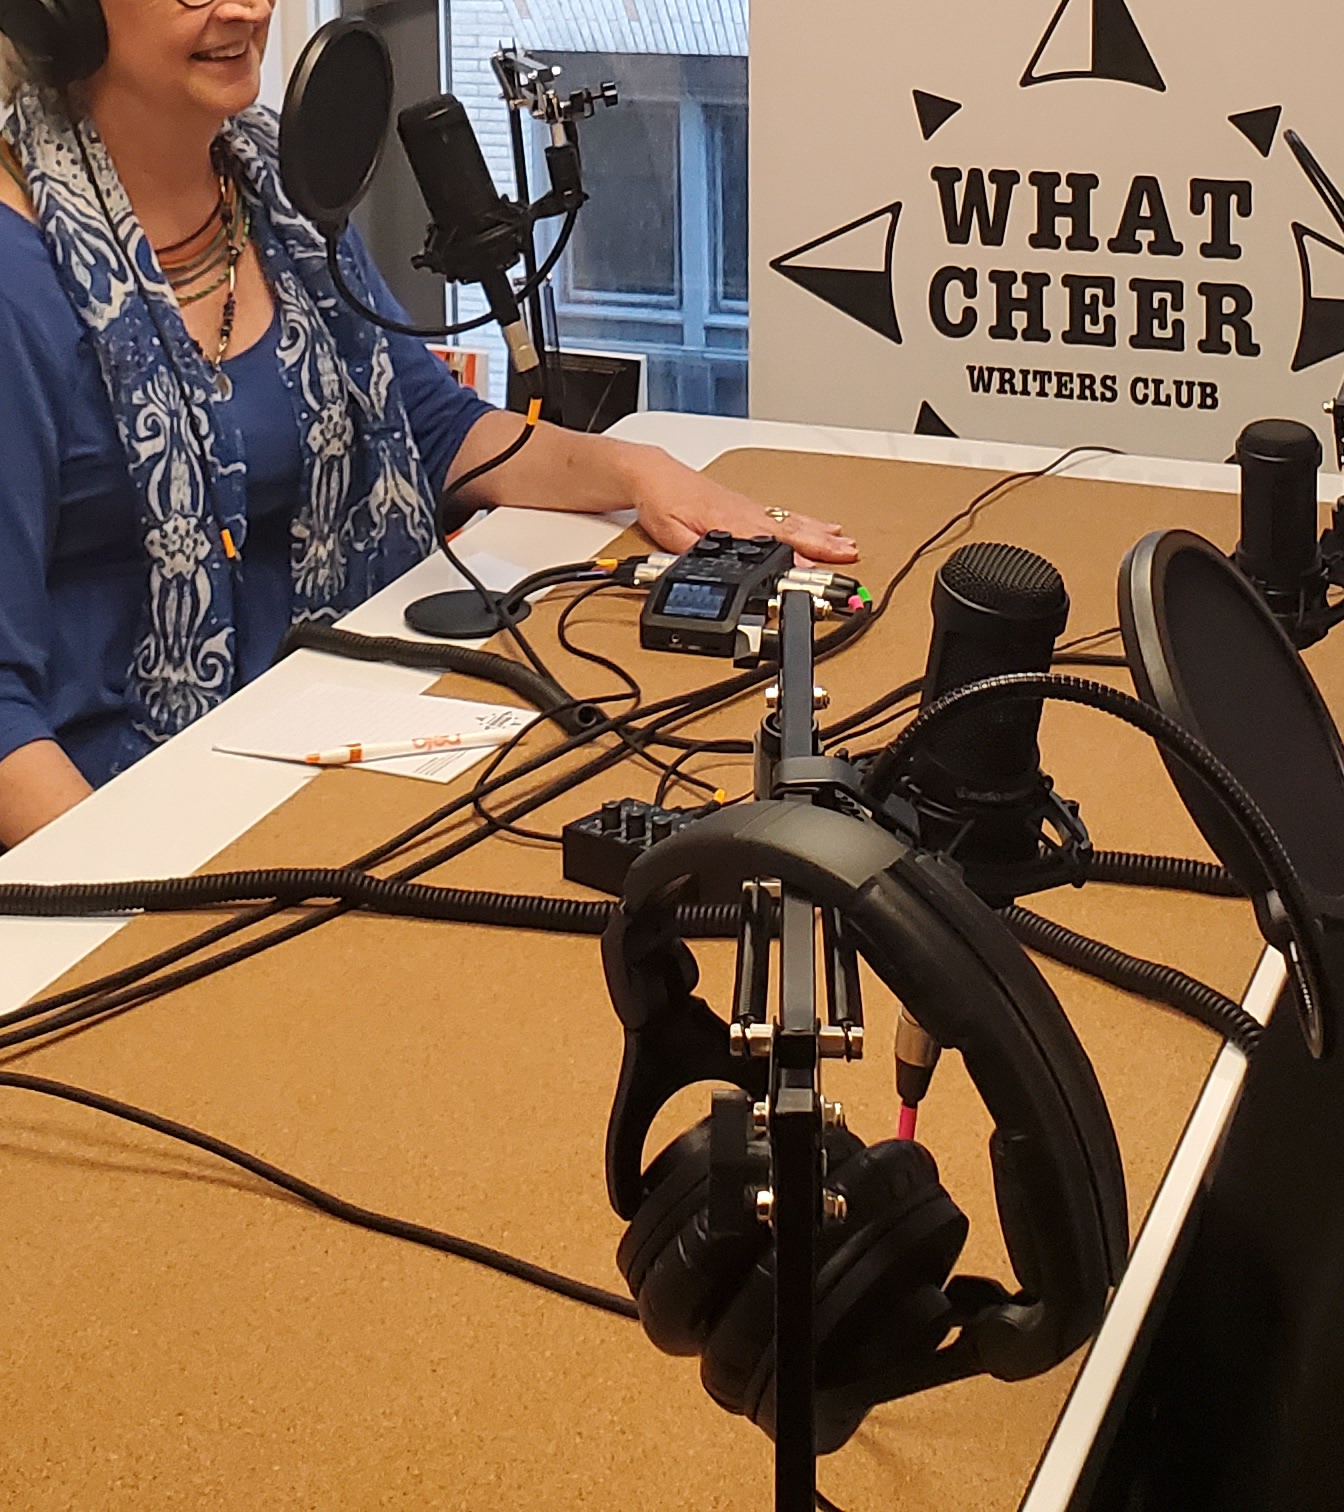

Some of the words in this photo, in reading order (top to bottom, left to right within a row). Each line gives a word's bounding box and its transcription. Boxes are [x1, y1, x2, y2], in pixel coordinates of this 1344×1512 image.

[930, 165, 1253, 260] WHAT
[928, 264, 1261, 358] CHEER
[966, 364, 1118, 403] WRITERS
[1130, 376, 1219, 410] CLUB
